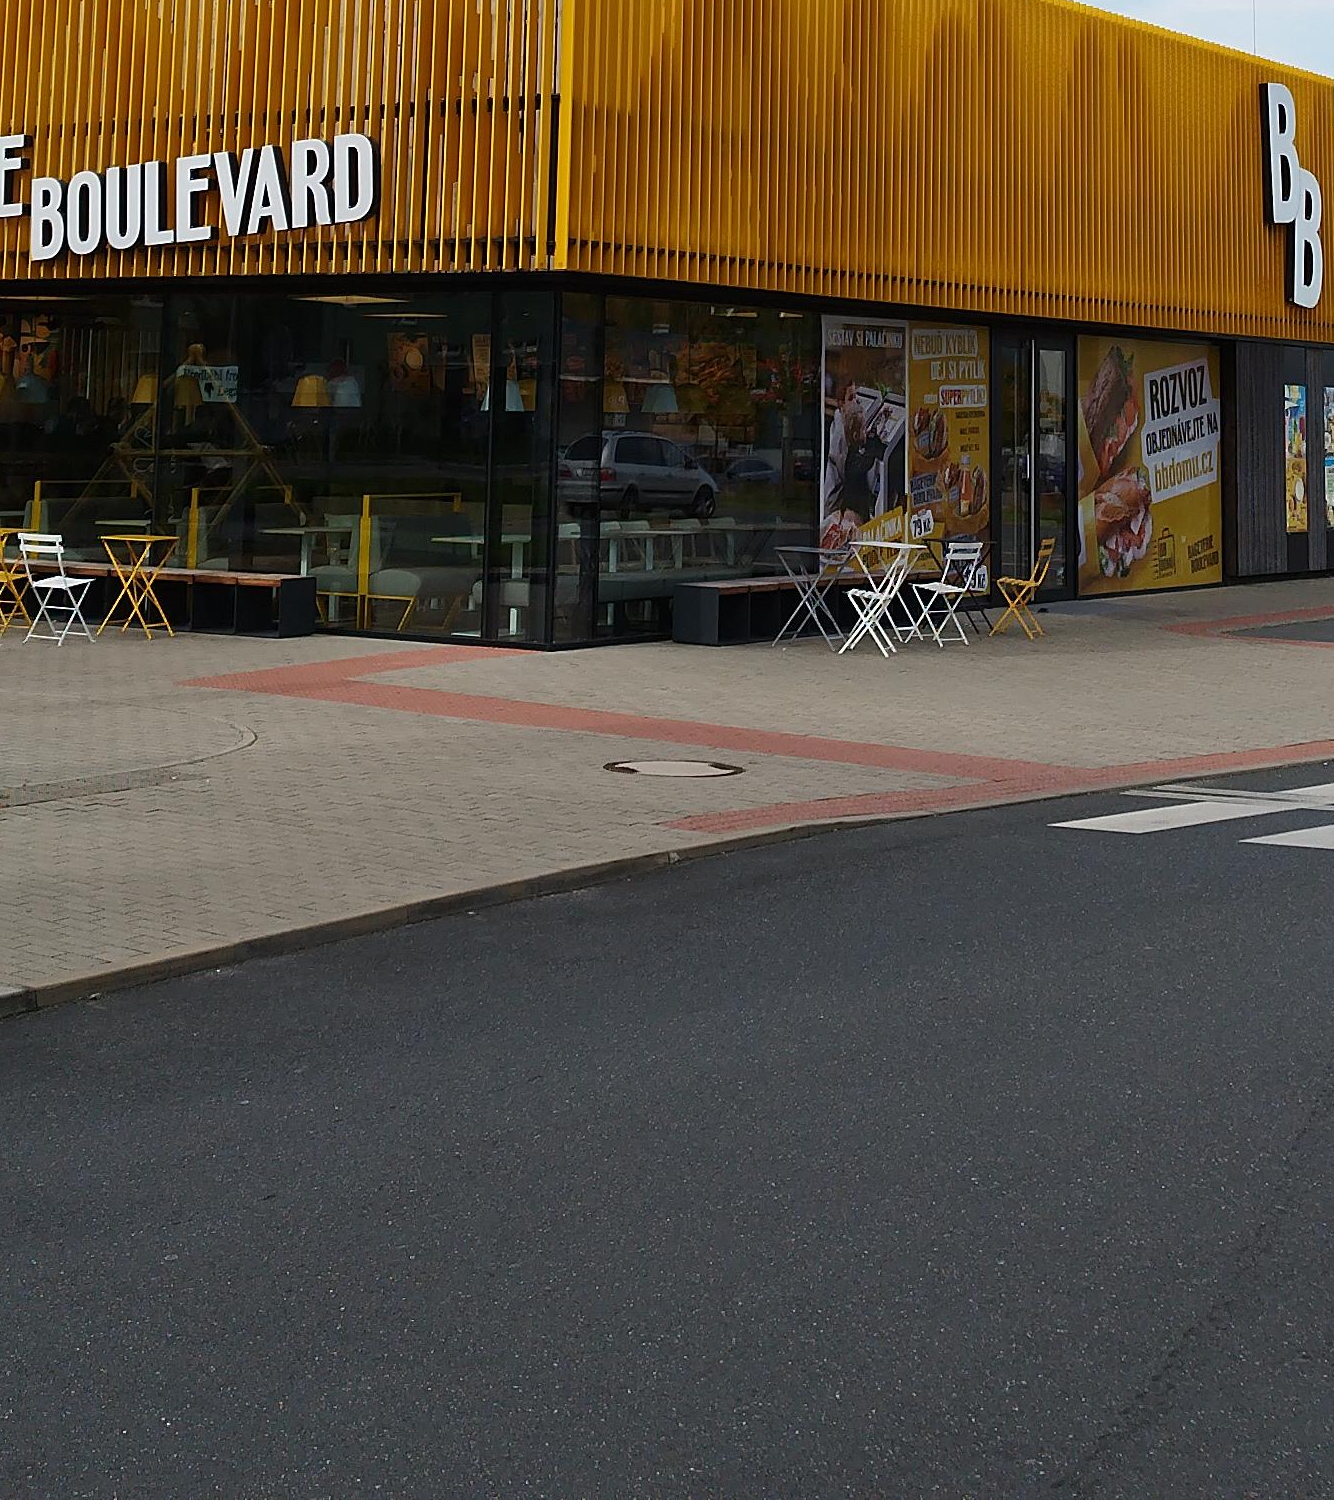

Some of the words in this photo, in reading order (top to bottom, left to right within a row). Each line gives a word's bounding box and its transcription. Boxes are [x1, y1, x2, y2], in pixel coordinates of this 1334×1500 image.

[30, 133, 375, 262] BOULEVARD
[948, 360, 957, 380] SI
[1149, 365, 1208, 421] ROZVOZ
[1145, 415, 1205, 457] OBJEDNÁVEJTE
[1207, 412, 1219, 438] NA
[1154, 450, 1214, 493] bbdomu.cz
[913, 518, 924, 538] 79
